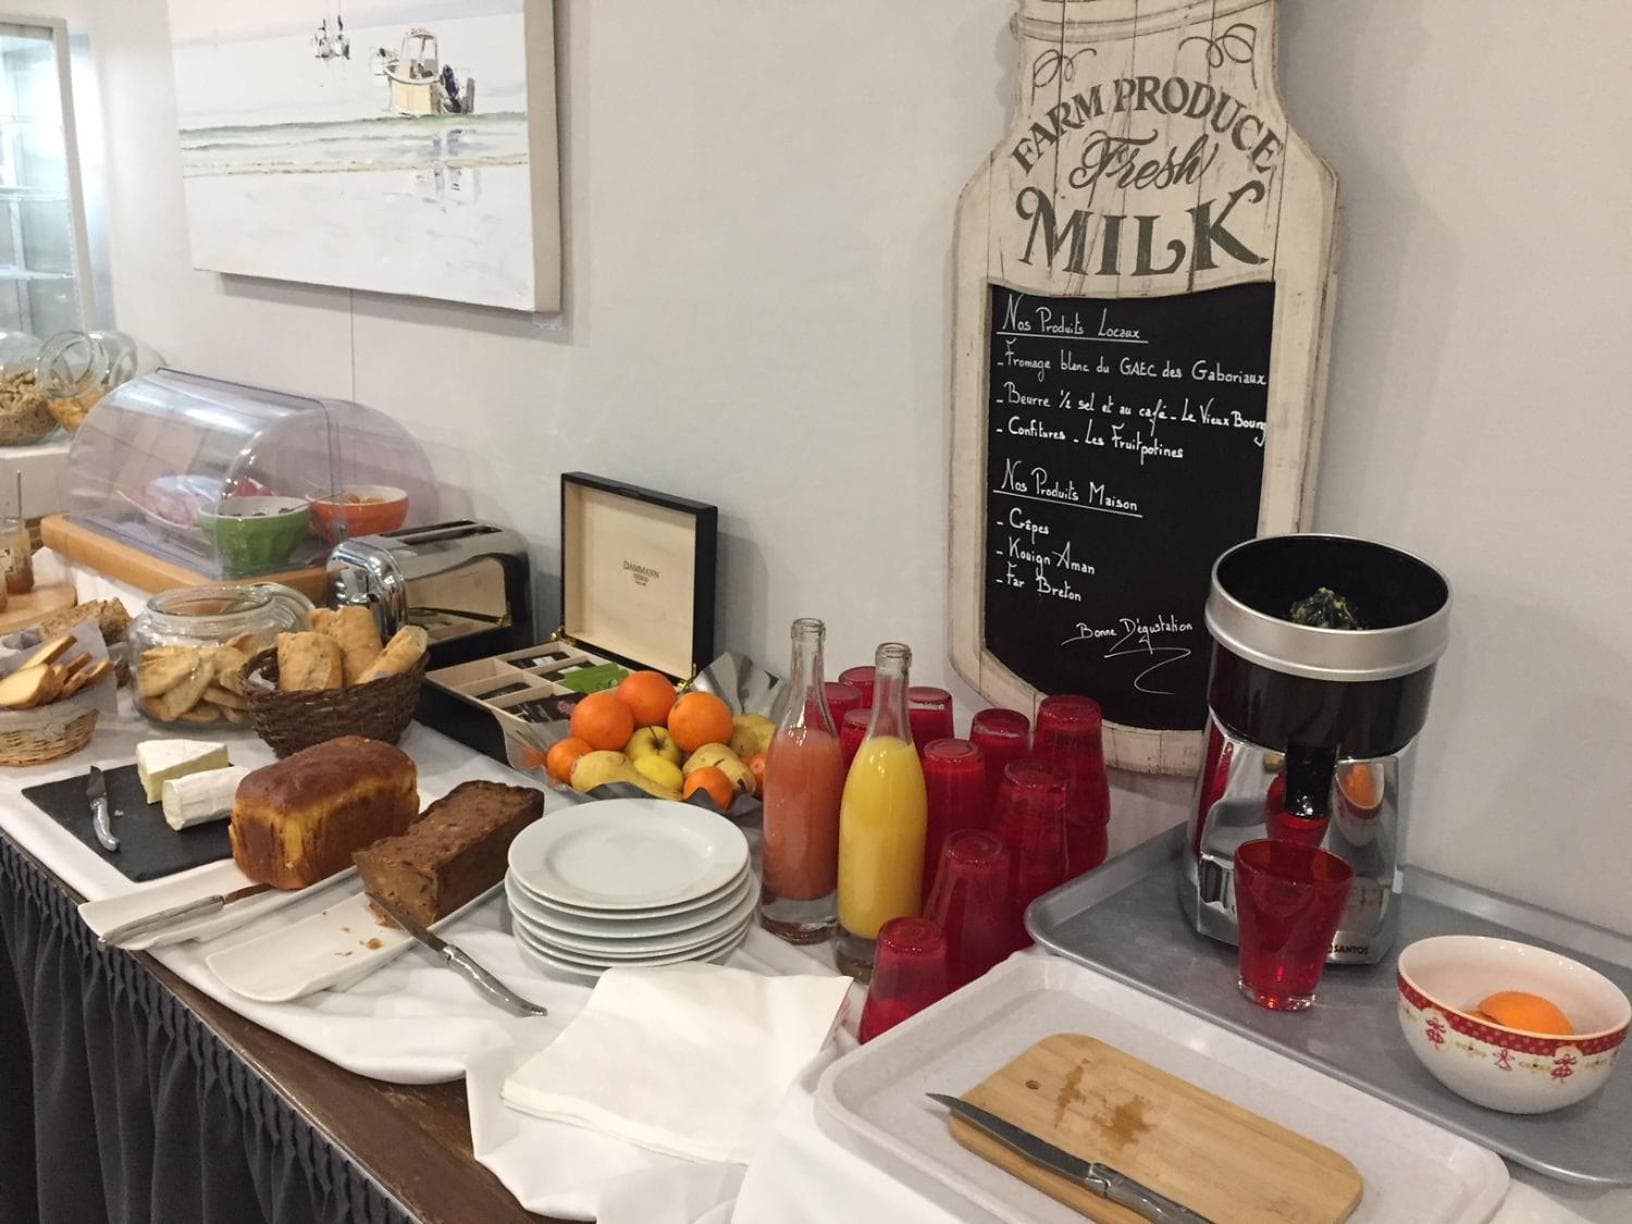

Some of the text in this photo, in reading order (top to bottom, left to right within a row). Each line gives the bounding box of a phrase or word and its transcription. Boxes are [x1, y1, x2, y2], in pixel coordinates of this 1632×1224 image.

[1010, 75, 1282, 176] FARM PRODUCE
[1069, 129, 1219, 190] Fresh
[1015, 179, 1269, 276] MILK
[1002, 293, 1140, 339] Nos Produits Locaux
[1060, 349, 1090, 372] blanc
[1096, 355, 1110, 373] du
[1119, 357, 1157, 377] GAEC
[1162, 360, 1182, 378] des
[1191, 360, 1267, 385] Gaboriaux
[1008, 416, 1066, 440] Confitures
[1085, 418, 1105, 446] Les
[1077, 392, 1095, 411] sel
[1101, 395, 1114, 413] et
[1119, 405, 1132, 416] au
[1181, 398, 1196, 422] Le
[1200, 398, 1229, 427] Vieux
[1231, 410, 1267, 447] Bourg
[1001, 458, 1138, 512] Nos Produits Maison
[1009, 507, 1050, 545] Crêpes
[1052, 541, 1095, 575] Aman
[1006, 561, 1025, 588] Far
[1035, 576, 1082, 602] Breton
[1066, 622, 1117, 643] Bonne
